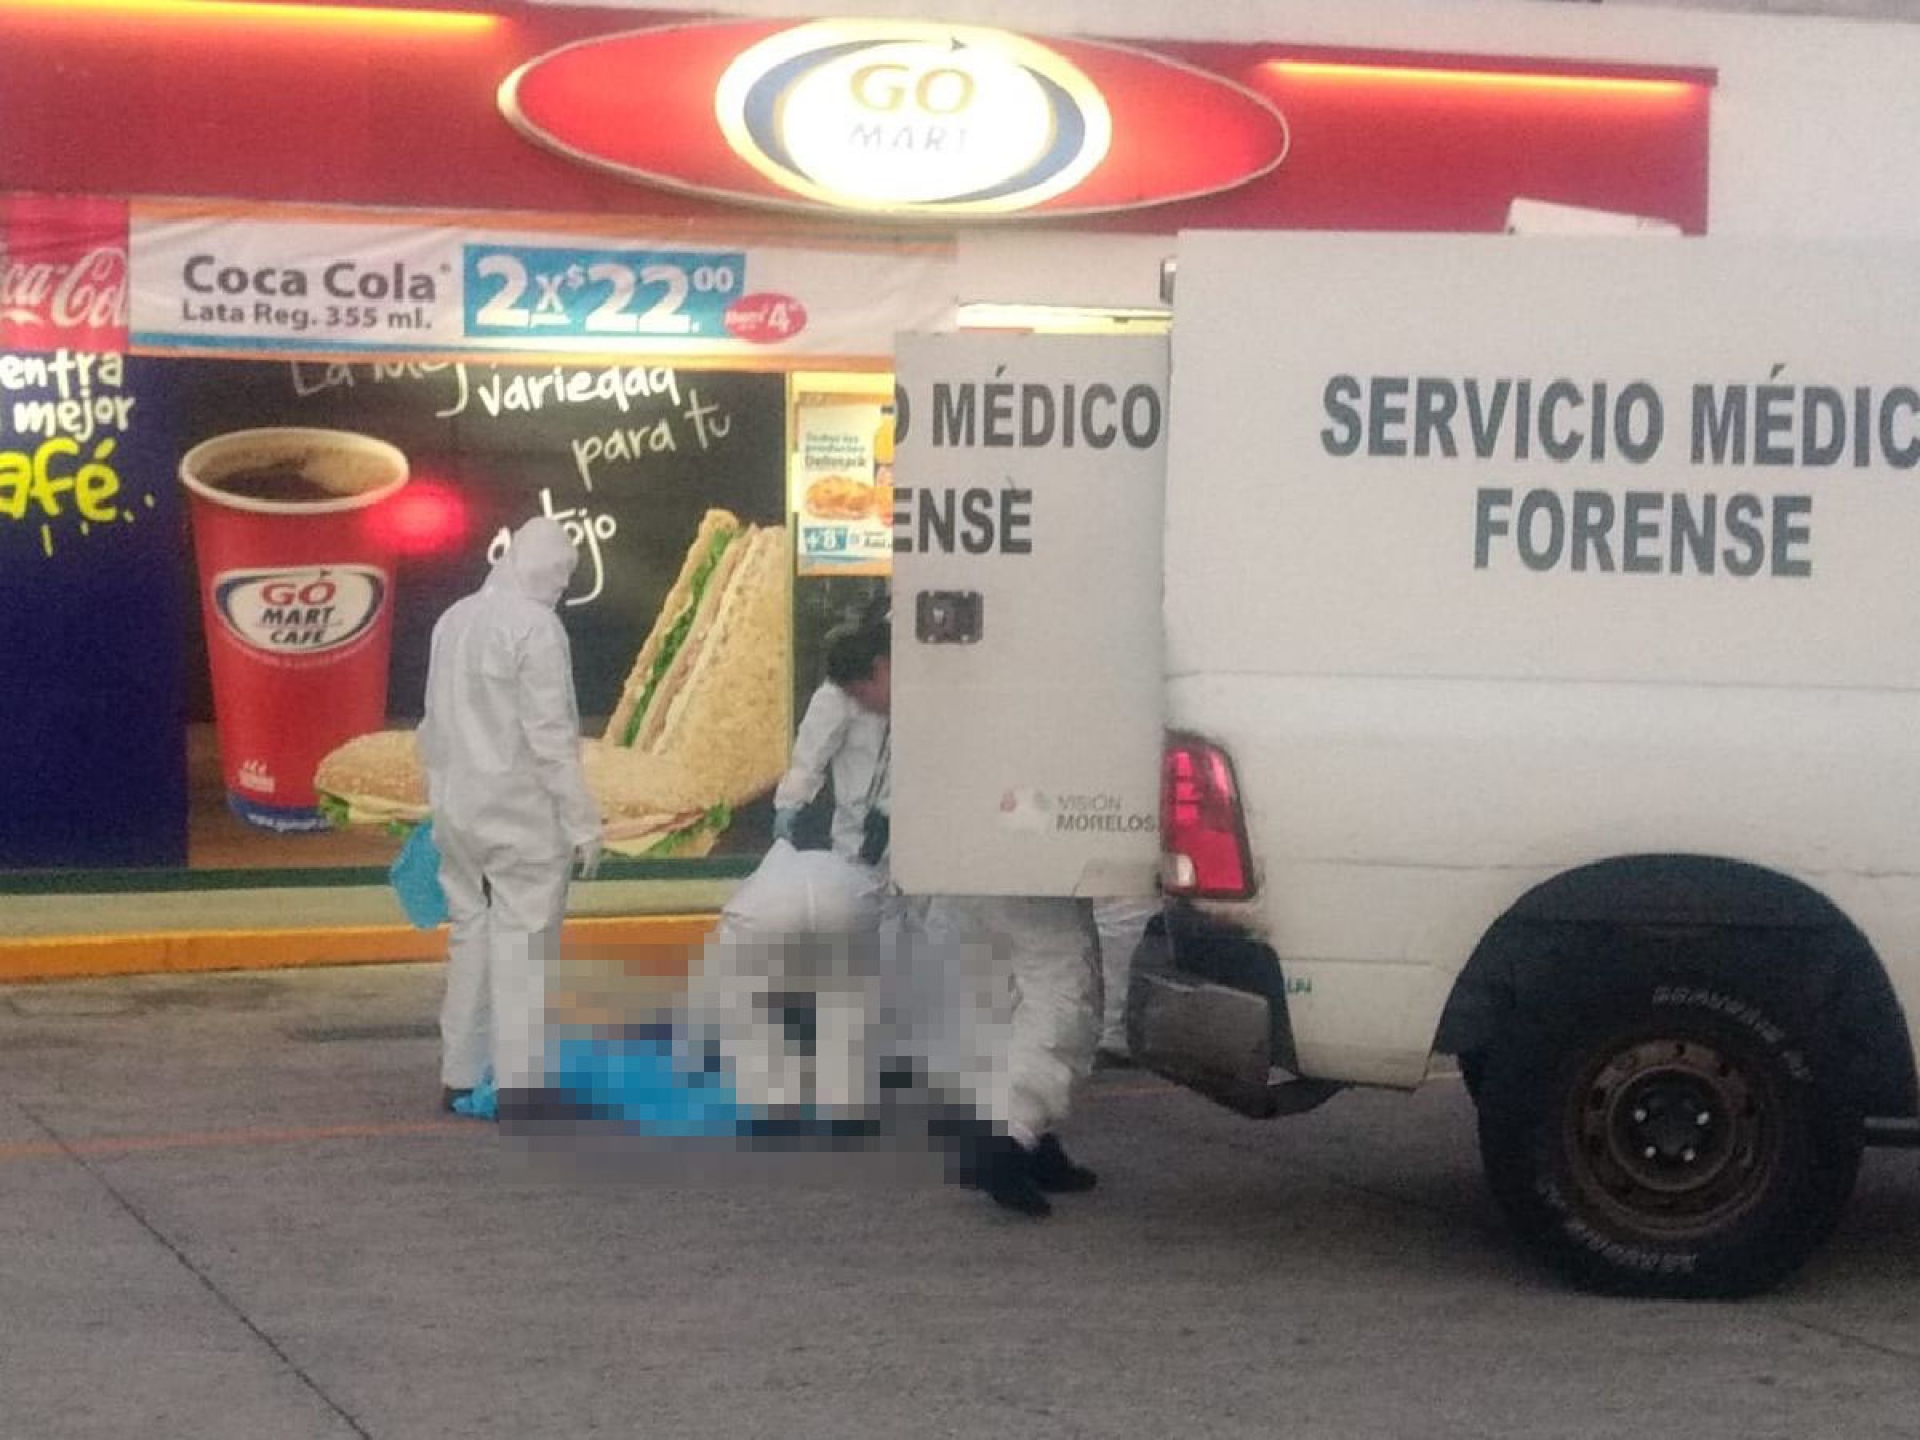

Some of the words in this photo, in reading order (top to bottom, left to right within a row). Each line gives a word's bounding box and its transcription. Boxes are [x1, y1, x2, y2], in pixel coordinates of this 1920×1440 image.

[850, 63, 975, 114] GO
[183, 255, 307, 296] Coca
[183, 301, 245, 322] Lata
[253, 303, 317, 331] Reg.
[325, 306, 378, 327] 355
[387, 308, 433, 329] ml.
[13, 388, 136, 441] mejor
[932, 365, 1161, 450] MÉDICO
[1320, 374, 1664, 464] SERVICIO
[572, 418, 677, 492] para
[684, 388, 731, 449] tu
[487, 487, 617, 606] atojo
[1474, 487, 1812, 577] FORENSE
[262, 607, 335, 625] MART
[1055, 814, 1156, 832] MORELOS
